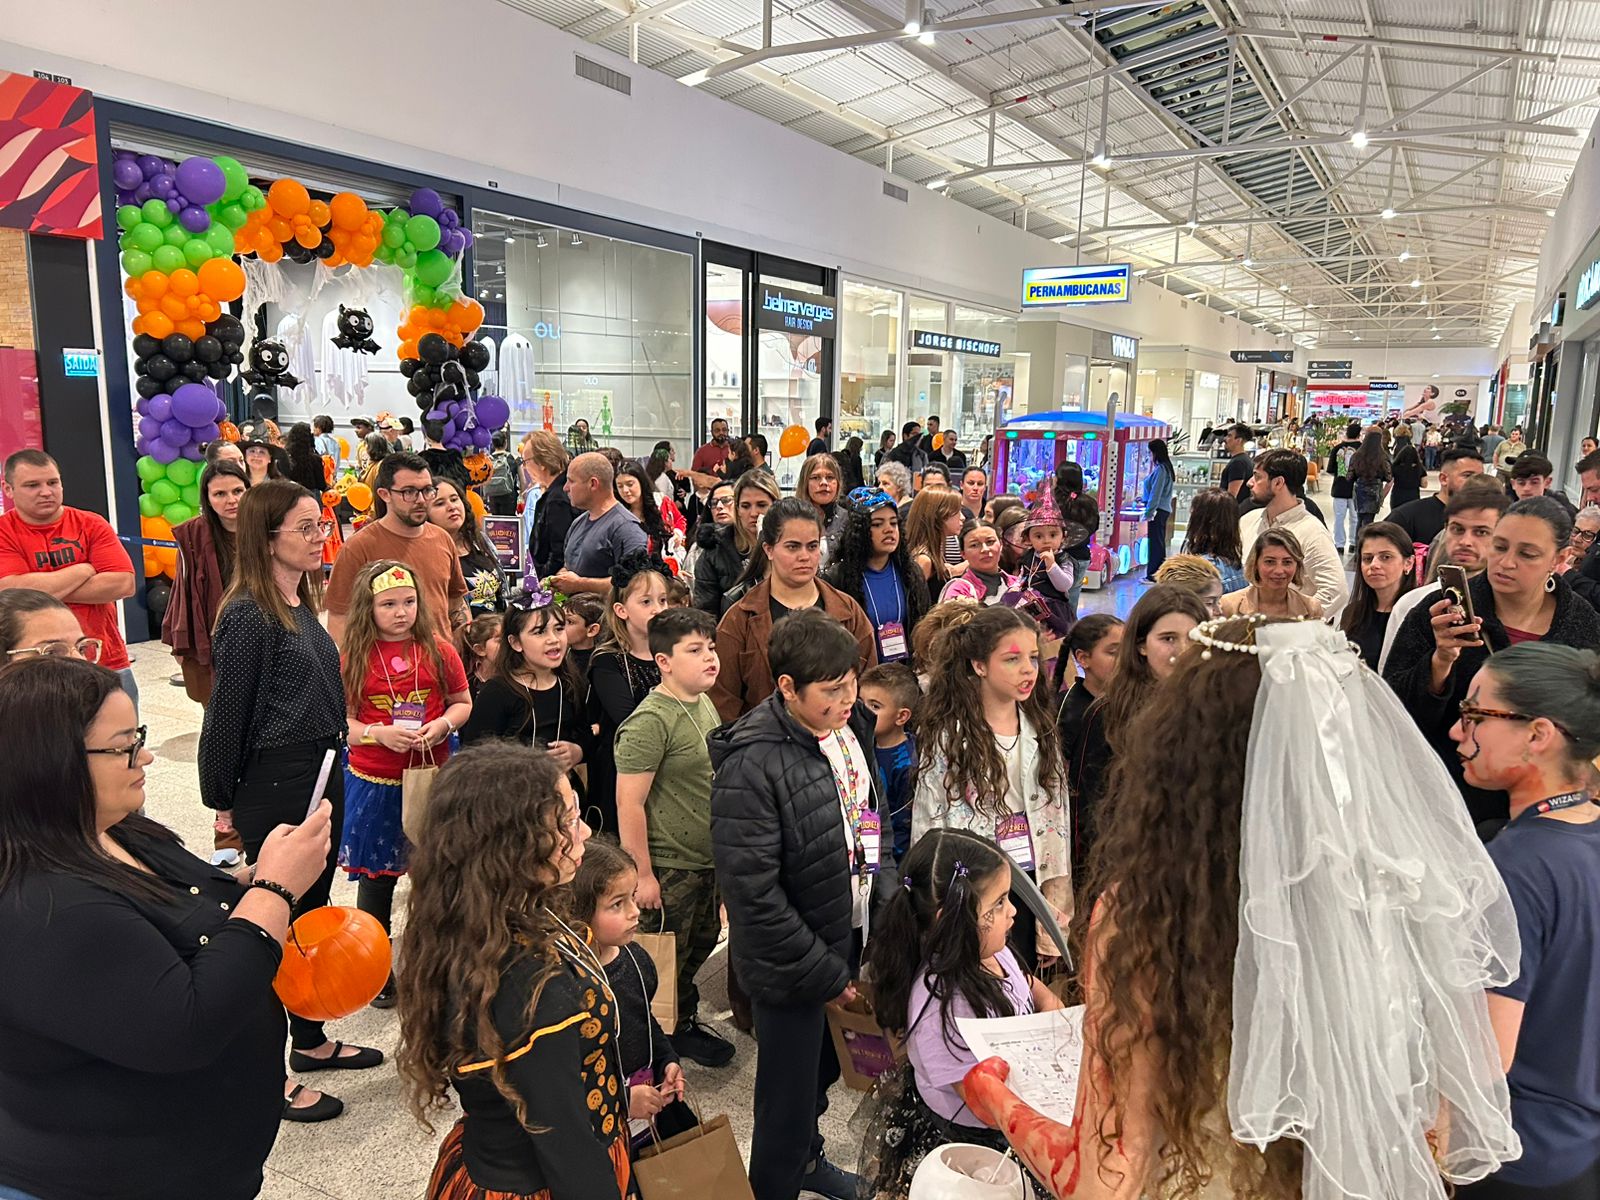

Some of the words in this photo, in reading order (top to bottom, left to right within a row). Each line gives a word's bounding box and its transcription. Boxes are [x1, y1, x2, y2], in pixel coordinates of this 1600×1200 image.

[1029, 282, 1121, 298] PERNAMBUCANAS
[762, 289, 834, 323] belmarvargas
[784, 315, 797, 328] HAIR
[797, 317, 813, 331] DESIGN
[918, 333, 953, 349] JORGE
[955, 338, 1000, 355] BISCHOFF
[35, 546, 76, 568] PMA
